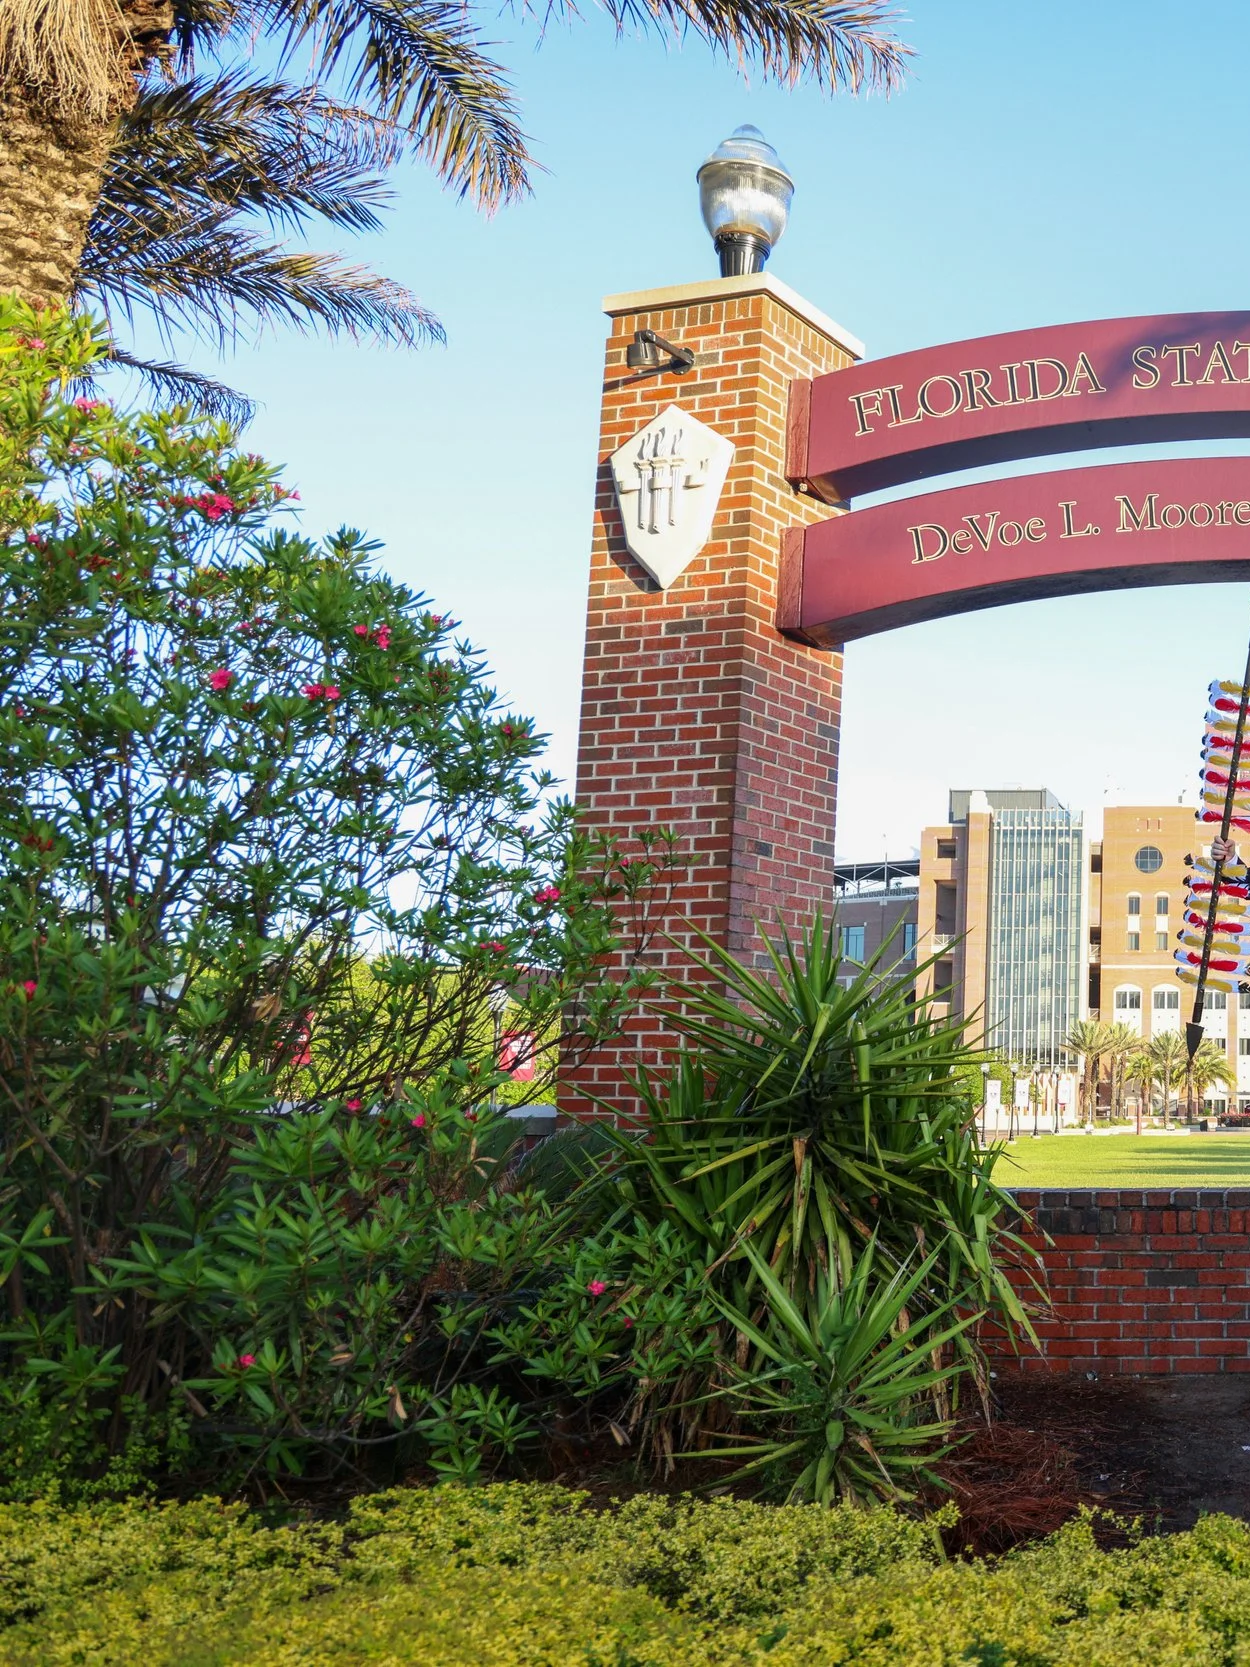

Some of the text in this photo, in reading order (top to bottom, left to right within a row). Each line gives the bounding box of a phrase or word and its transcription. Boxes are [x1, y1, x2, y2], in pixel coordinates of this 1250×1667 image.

[848, 351, 1107, 437] FLORIDA
[907, 510, 1047, 565] DeVoe
[1058, 500, 1101, 539] L.
